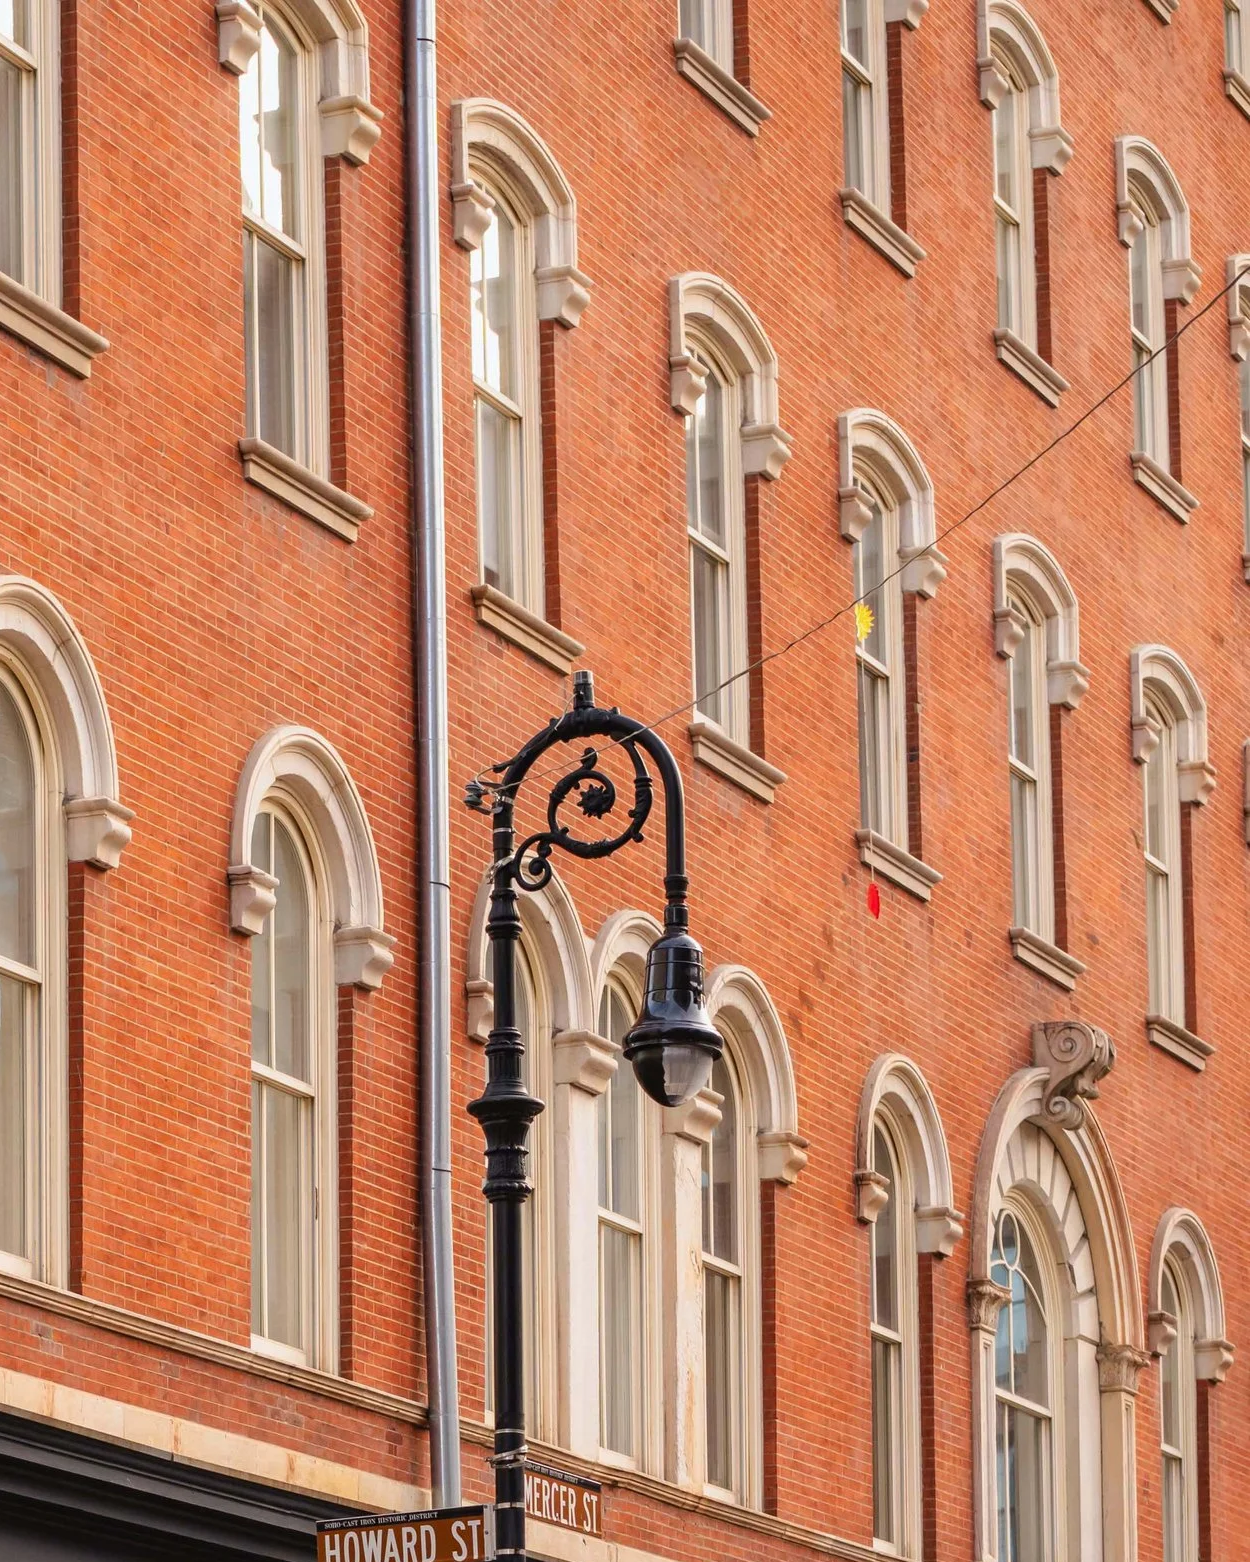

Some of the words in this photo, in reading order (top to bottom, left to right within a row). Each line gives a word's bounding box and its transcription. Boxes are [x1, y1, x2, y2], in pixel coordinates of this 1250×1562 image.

[360, 1518, 376, 1526] IRON
[378, 1515, 408, 1525] HISTORIC
[408, 1512, 438, 1522] DISTRICT
[524, 1473, 578, 1528] MERCER
[583, 1491, 598, 1533] ST
[451, 1519, 481, 1562] ST
